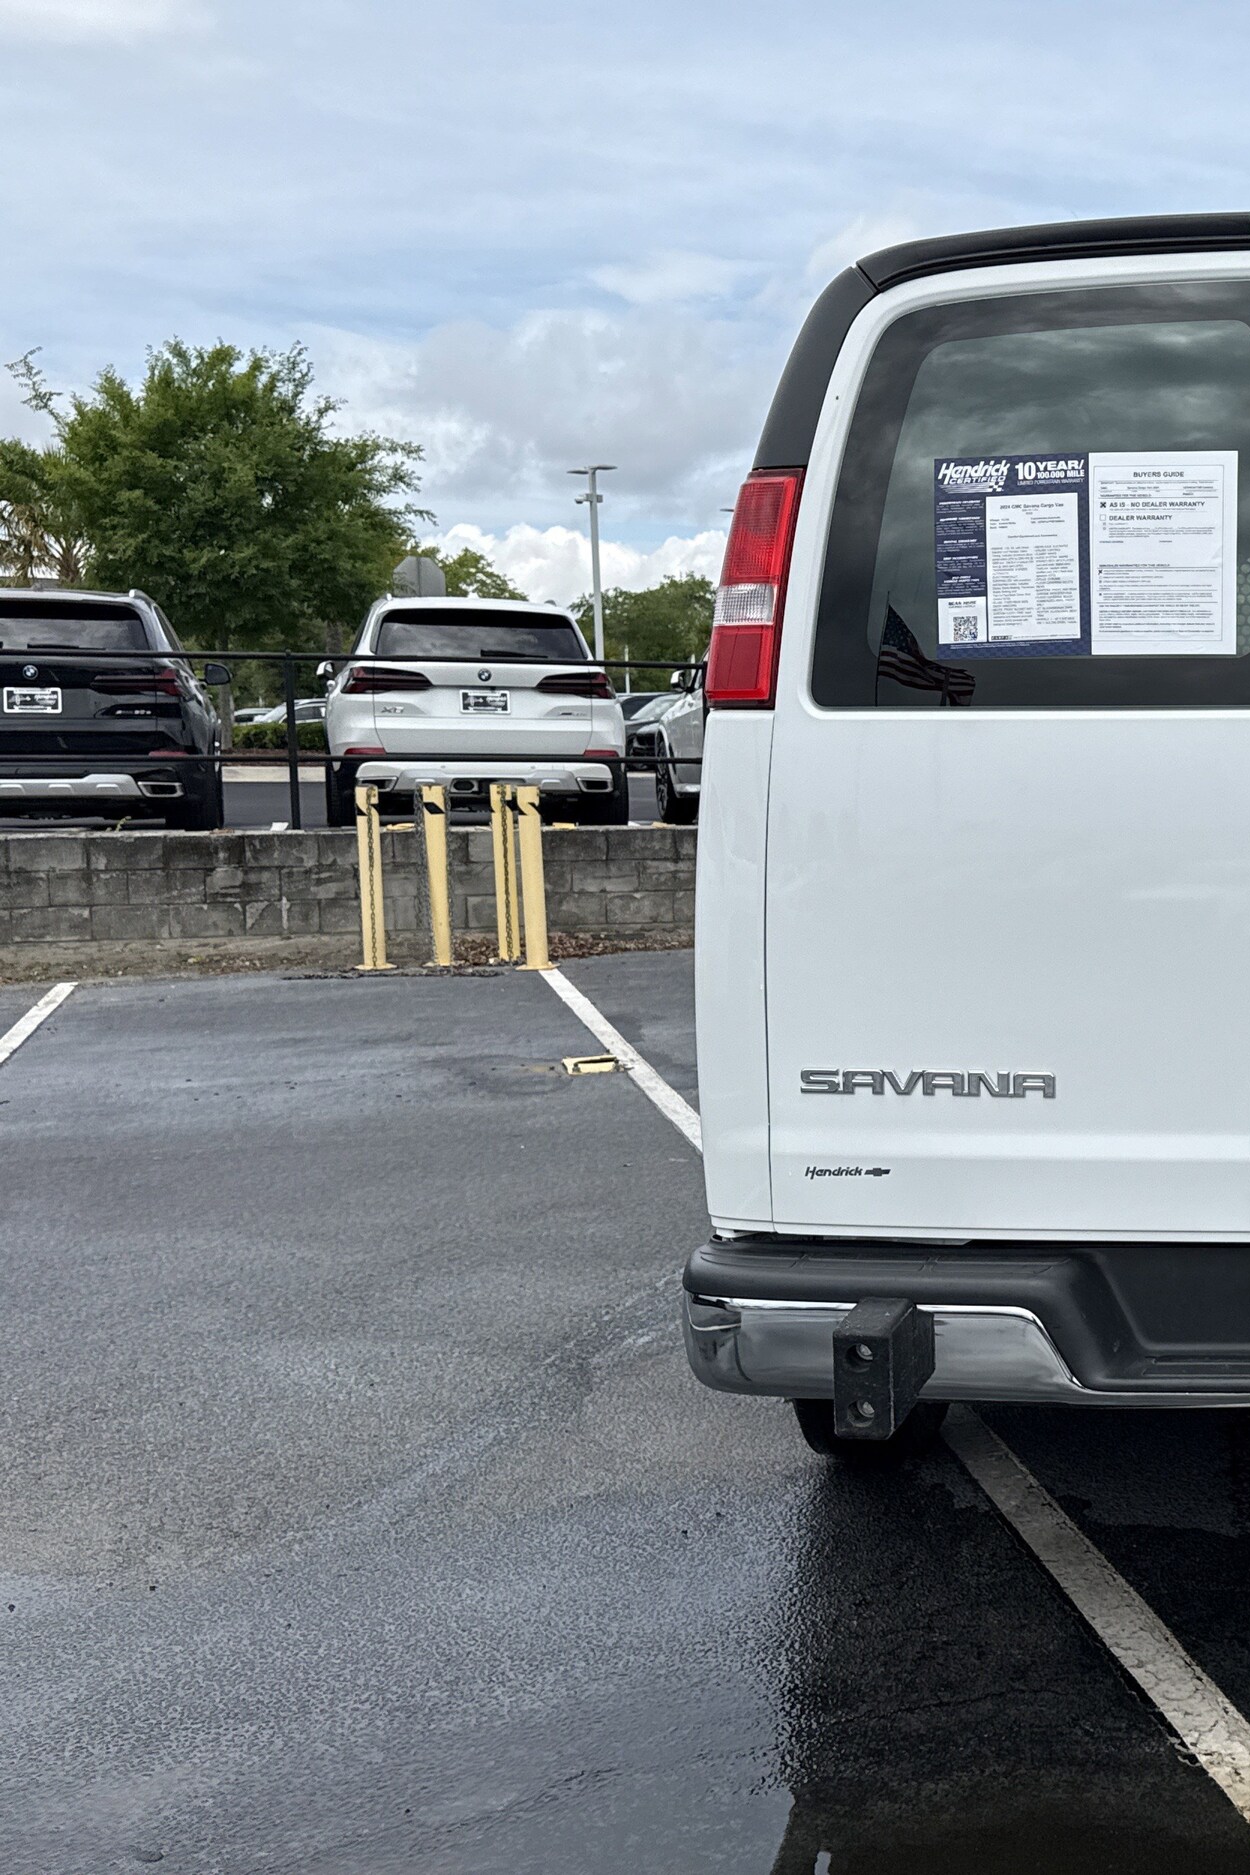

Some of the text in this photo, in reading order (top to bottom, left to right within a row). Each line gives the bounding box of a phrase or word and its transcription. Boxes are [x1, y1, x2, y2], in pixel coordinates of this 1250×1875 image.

[938, 460, 1010, 485] Hendrick
[1014, 459, 1085, 480] 10 YEAR/
[1067, 470, 1085, 478] MILE
[949, 476, 1006, 484] CERTIFIED
[800, 1067, 1056, 1099] SAVANA
[804, 1166, 863, 1180] Hendrick
